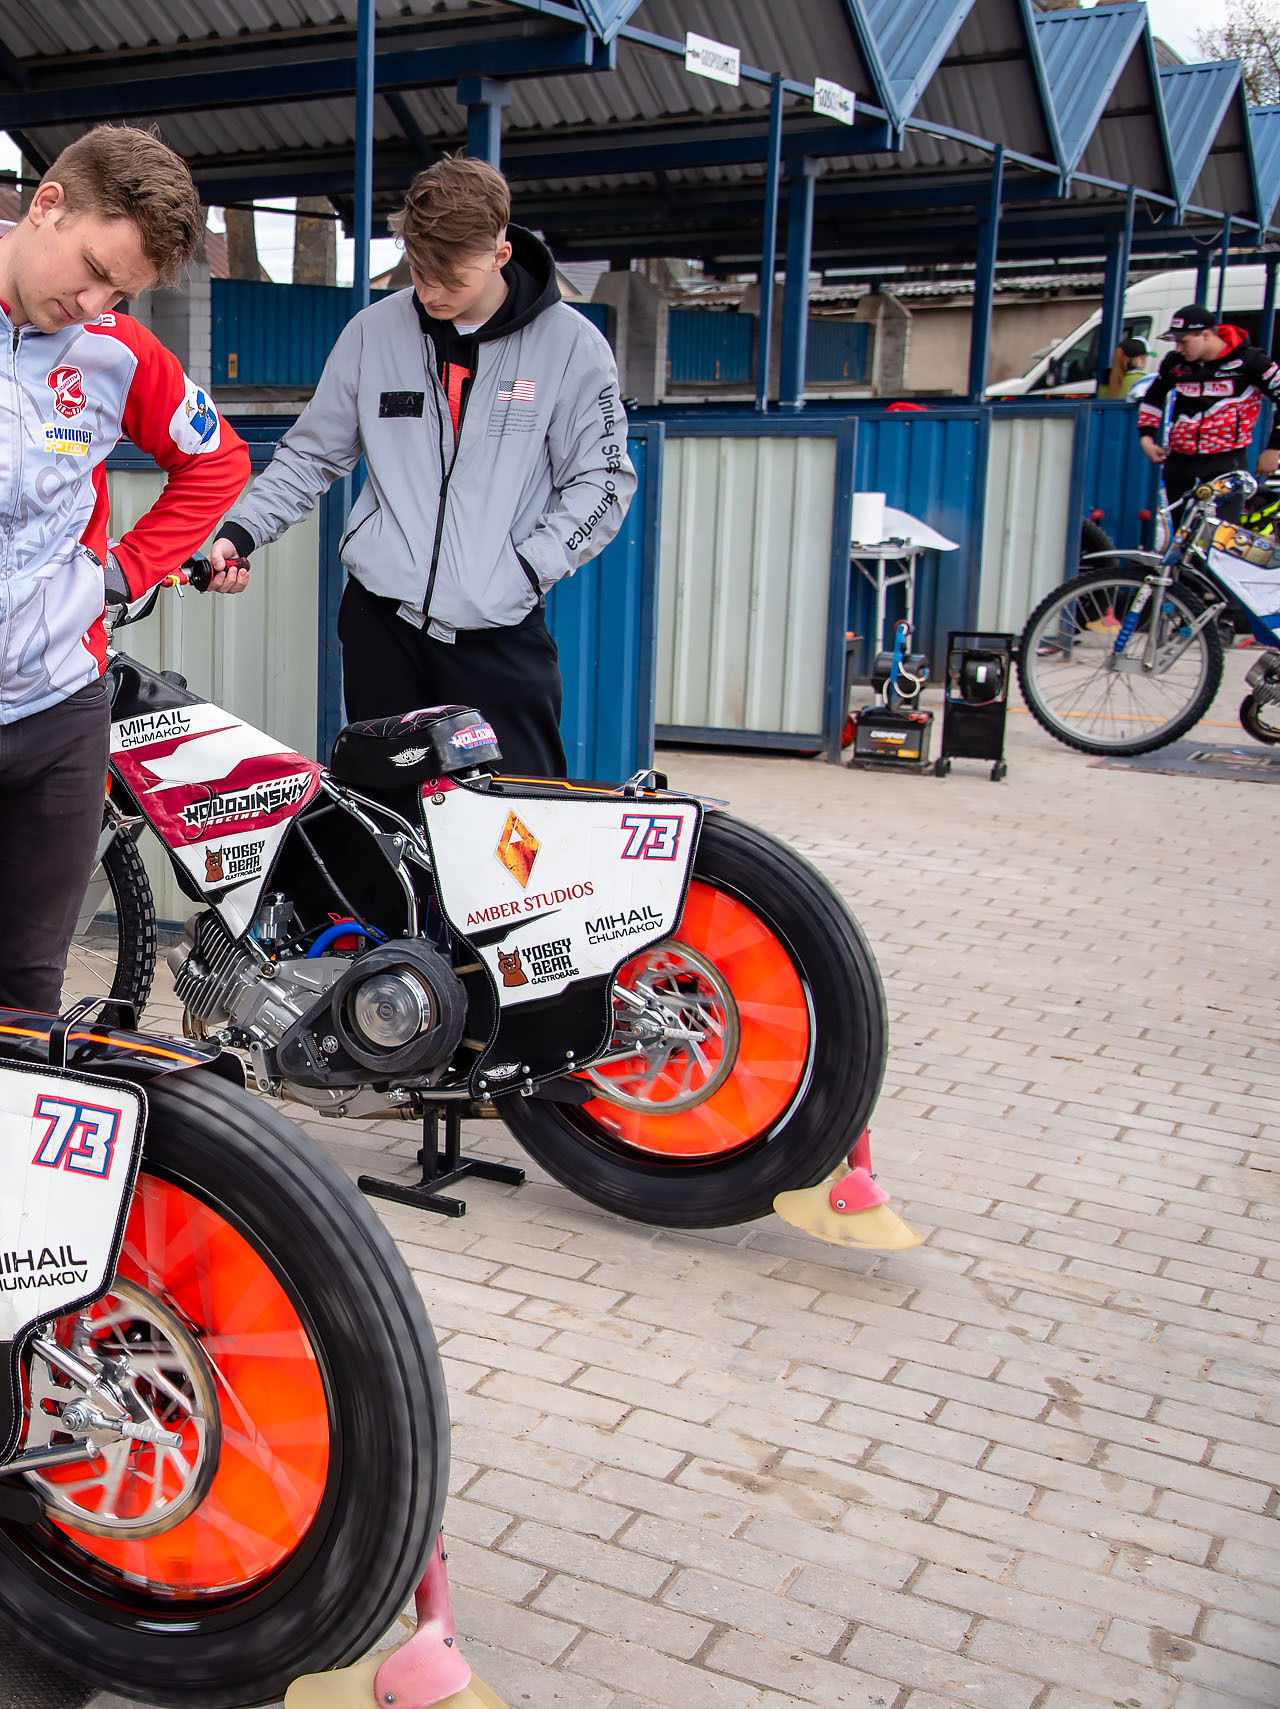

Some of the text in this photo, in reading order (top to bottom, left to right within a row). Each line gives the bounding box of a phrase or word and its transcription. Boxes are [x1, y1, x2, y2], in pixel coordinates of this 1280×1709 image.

[118, 710, 191, 738] MIHAIL
[121, 723, 191, 748] CHUMAKOV
[223, 839, 266, 861] YOGGY
[620, 813, 685, 862] 73
[229, 854, 261, 874] BEAR
[466, 881, 595, 927] AMBER STUDIOS
[585, 905, 663, 935] MIHAIL
[588, 918, 664, 945] CHUMAKOV
[522, 937, 572, 963] YOGGY
[531, 955, 573, 976] BEAR
[31, 1093, 123, 1180] 73
